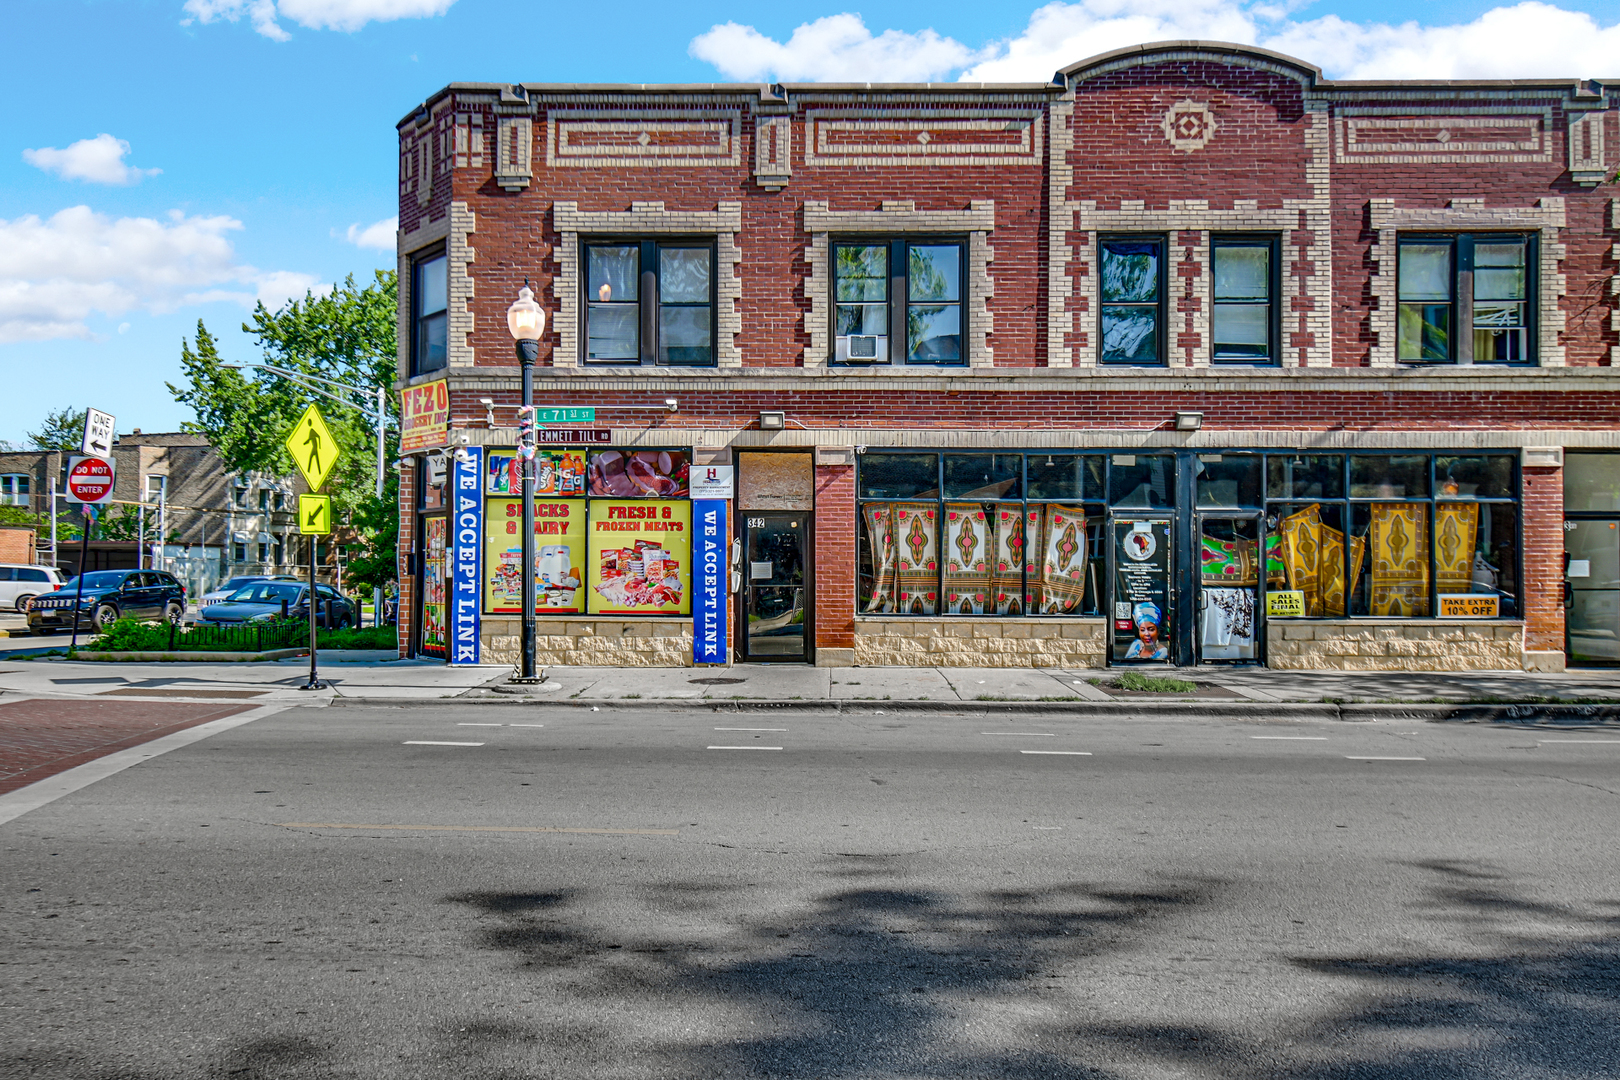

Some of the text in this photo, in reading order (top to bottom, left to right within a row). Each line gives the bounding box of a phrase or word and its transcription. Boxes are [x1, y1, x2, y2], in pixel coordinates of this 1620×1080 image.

[404, 382, 447, 417] FEZO
[93, 413, 111, 429] ONE
[434, 411, 447, 425] INC
[91, 424, 111, 440] WAY
[540, 430, 609, 442] EMMETT TILL RD
[76, 466, 108, 474] DO NOT
[563, 469, 571, 479] G
[707, 468, 717, 478] H
[574, 476, 580, 484] G
[77, 485, 103, 494] ENTER
[506, 504, 570, 518] SCKS
[608, 506, 672, 519] FRESH &
[506, 521, 570, 535] & AIRY
[596, 521, 684, 532] FROZEN MEATS
[748, 518, 764, 528] 342
[457, 453, 478, 662] WE ACCEPT LINK
[704, 510, 717, 656] WE ACCEPT LINK
[1447, 606, 1493, 616] 10% OFF
